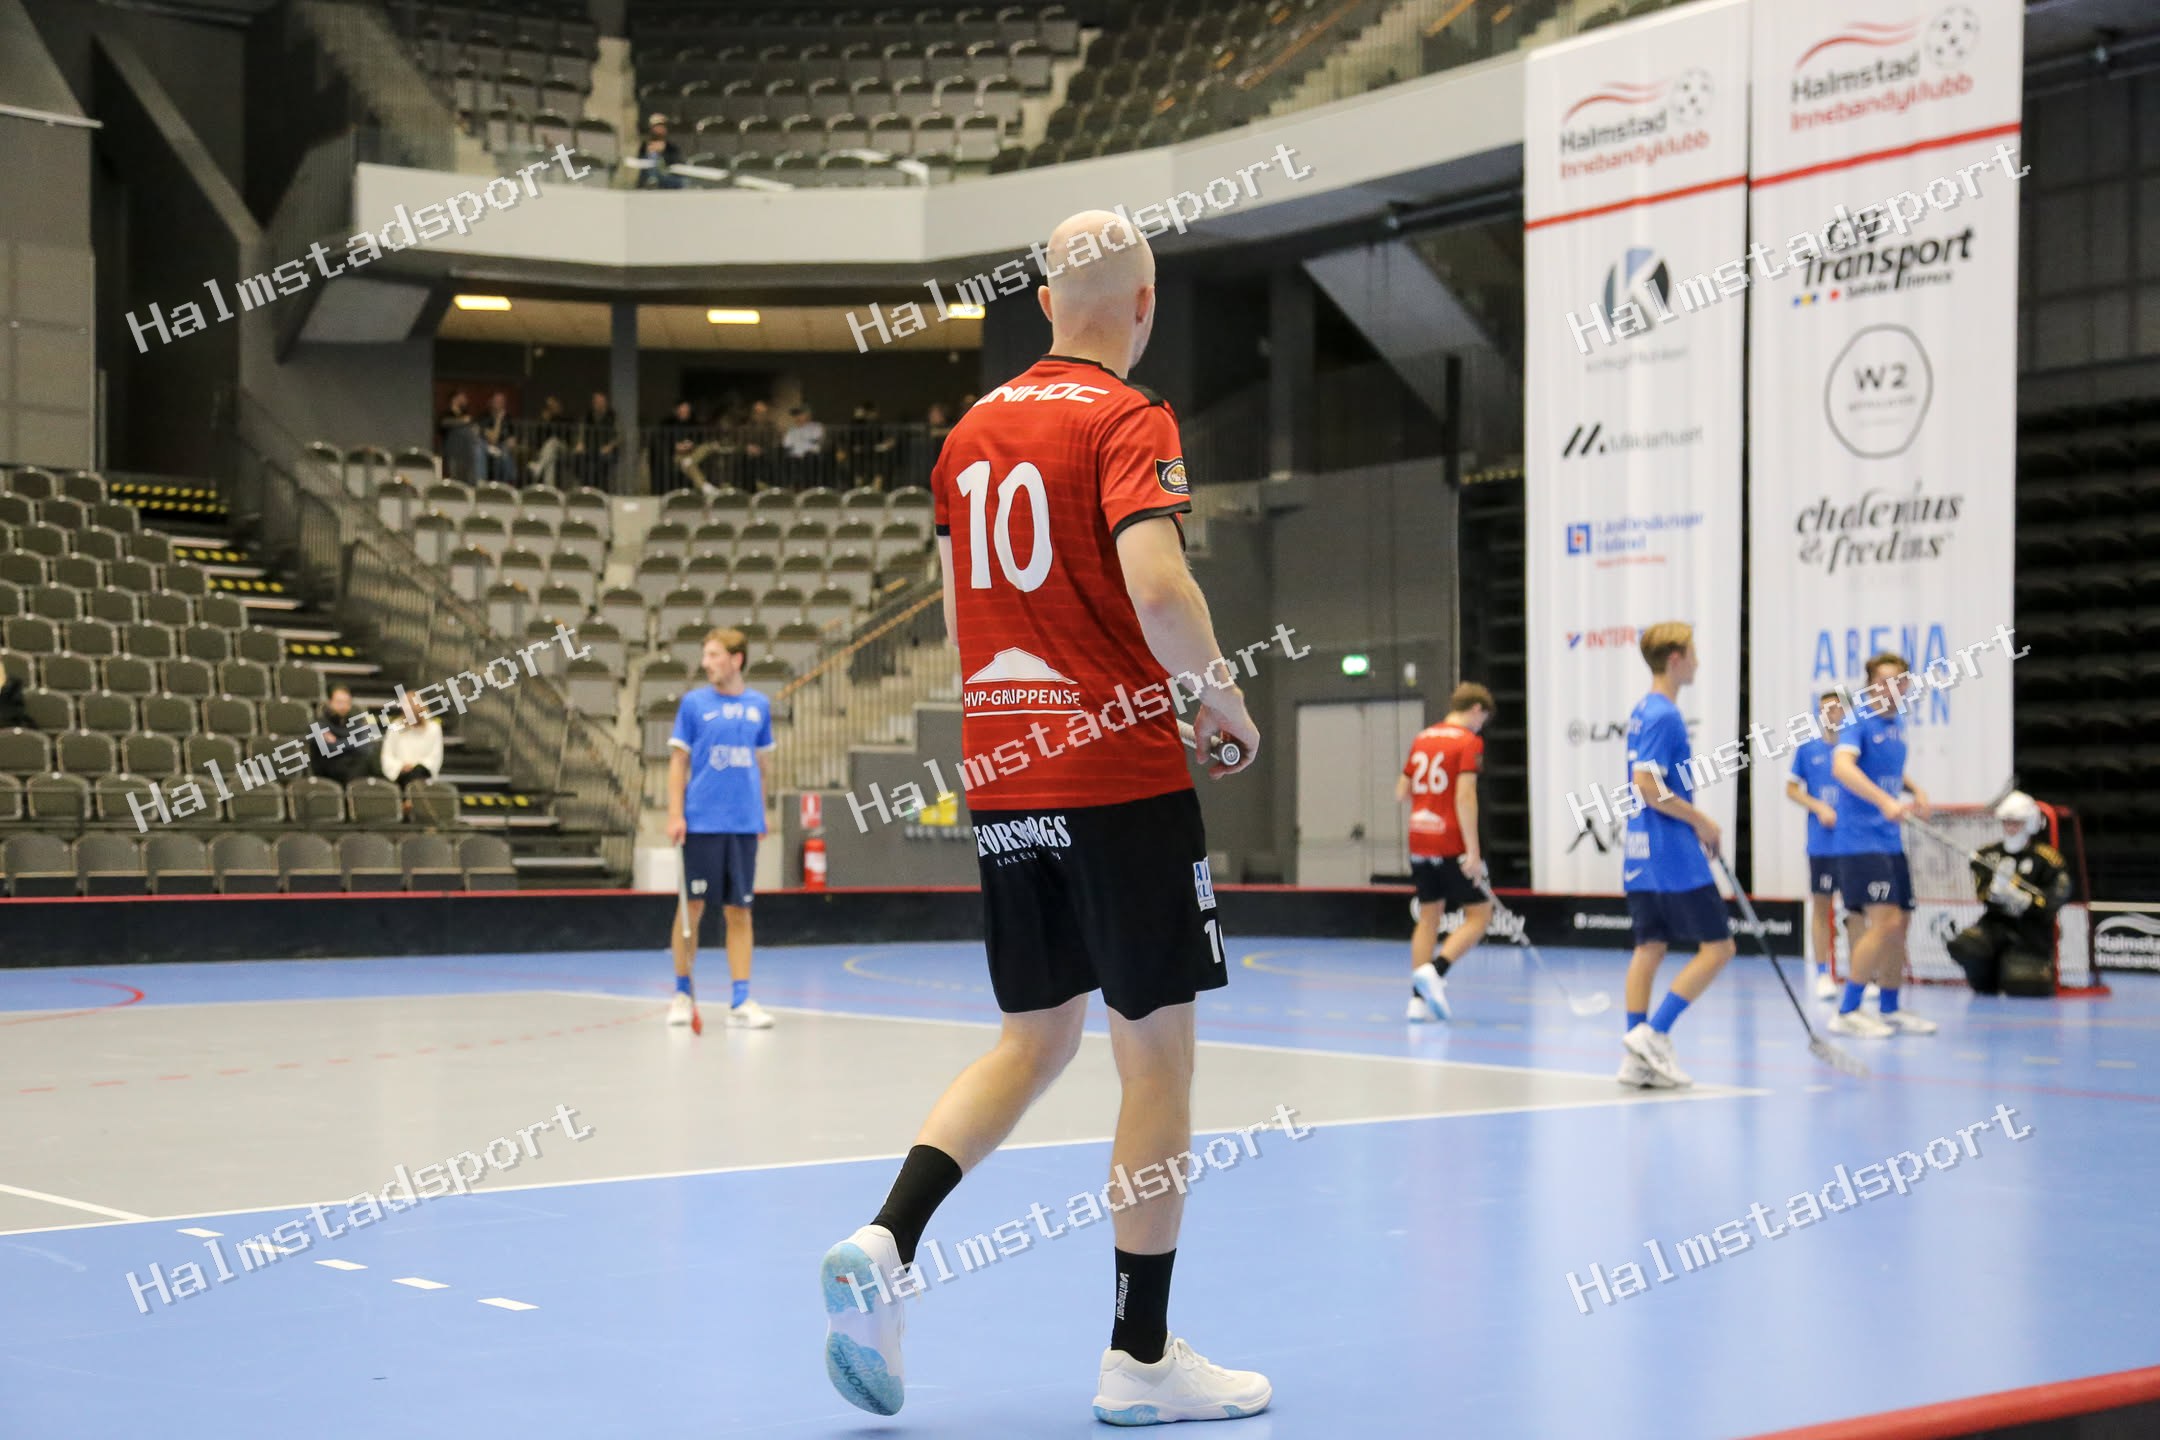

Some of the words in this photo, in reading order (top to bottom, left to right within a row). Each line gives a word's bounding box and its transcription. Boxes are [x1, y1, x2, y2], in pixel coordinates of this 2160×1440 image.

[1790, 72, 1974, 133] Innebandyklubb
[1792, 50, 1920, 103] Halmstad
[1560, 108, 1668, 155] Halmstad
[1560, 128, 1711, 181] Innebandyklubb
[1802, 224, 1974, 291] Transport
[956, 461, 1053, 592] 10
[1813, 623, 1949, 680] ARENA
[964, 688, 1081, 708] HVP-GRUPPEN.SE
[1411, 751, 1448, 794] 26
[1204, 919, 1225, 964] 1
